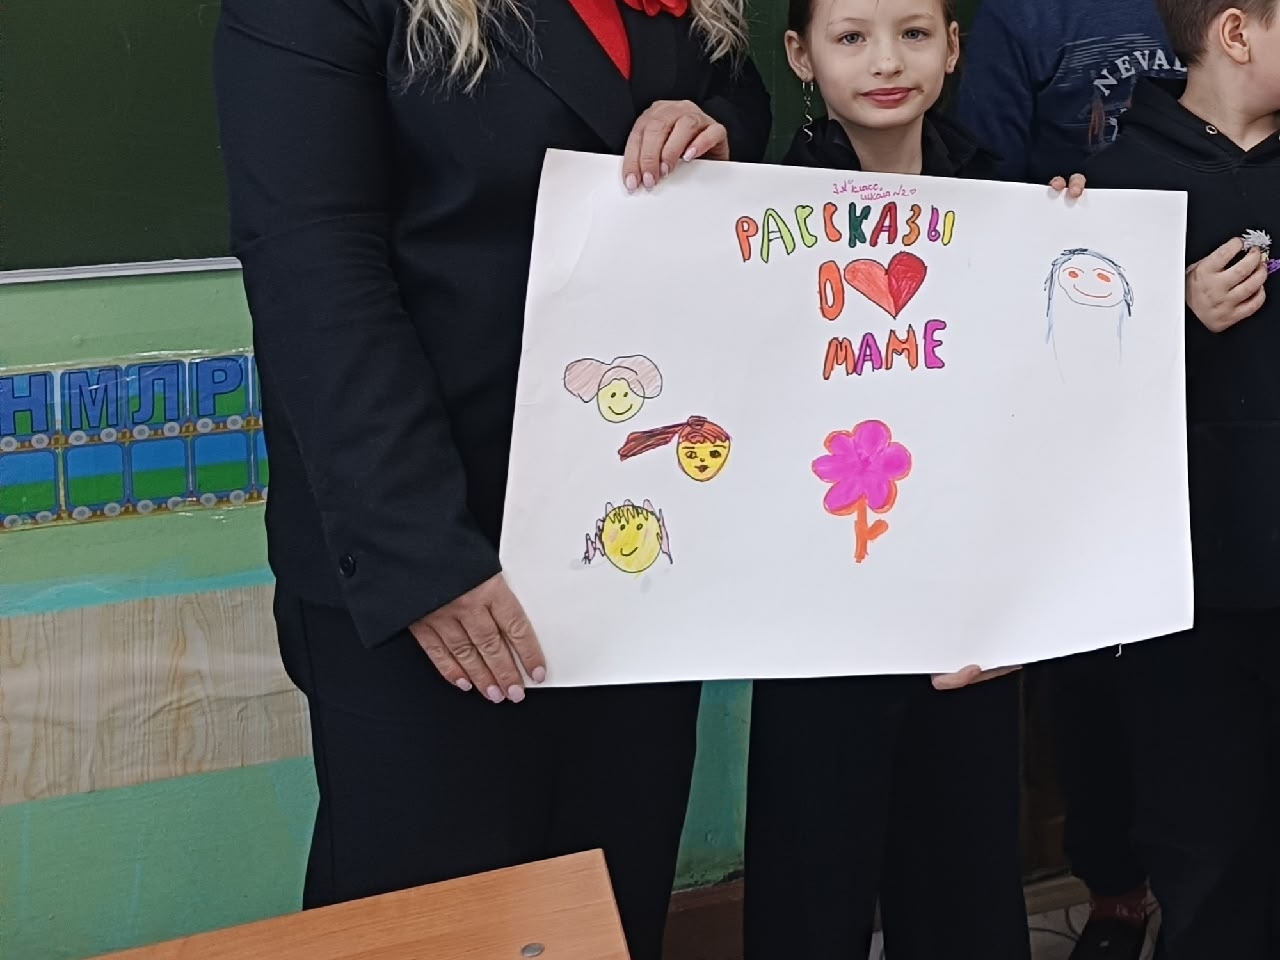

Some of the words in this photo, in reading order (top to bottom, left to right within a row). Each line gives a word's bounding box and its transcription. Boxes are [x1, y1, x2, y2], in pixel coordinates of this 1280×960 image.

[735, 201, 956, 263] РАССКАЗЫ
[818, 260, 844, 321] О
[823, 319, 946, 380] МАМЕ
[0, 373, 49, 435] Н
[68, 368, 119, 430] М
[132, 363, 180, 424] Л
[196, 357, 243, 416] Р
